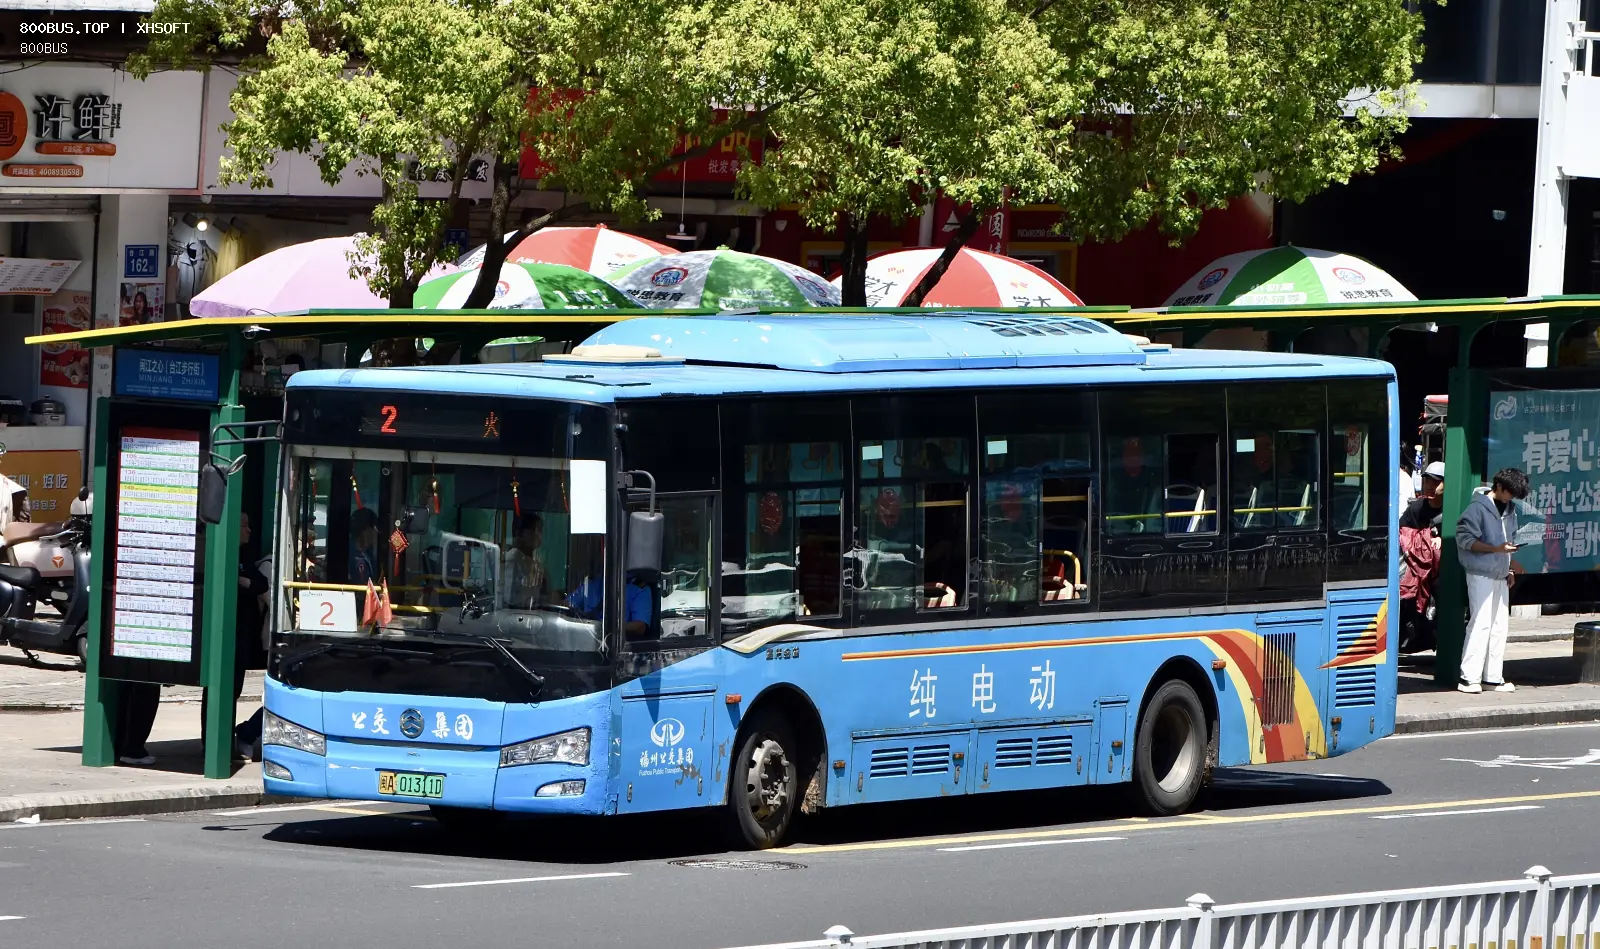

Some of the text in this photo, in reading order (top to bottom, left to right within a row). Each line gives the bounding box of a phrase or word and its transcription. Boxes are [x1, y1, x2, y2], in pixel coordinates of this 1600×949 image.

[35, 95, 111, 139] 许鲜
[130, 258, 148, 273] 162
[139, 374, 206, 386] MINJIANG ZHIXIN
[380, 405, 398, 433] 2
[1522, 428, 1600, 475] 有爱心
[319, 601, 335, 626] 2
[908, 659, 1056, 718] 纯电动
[351, 707, 474, 741] 公交 集团
[639, 747, 694, 768] 福州公交集团
